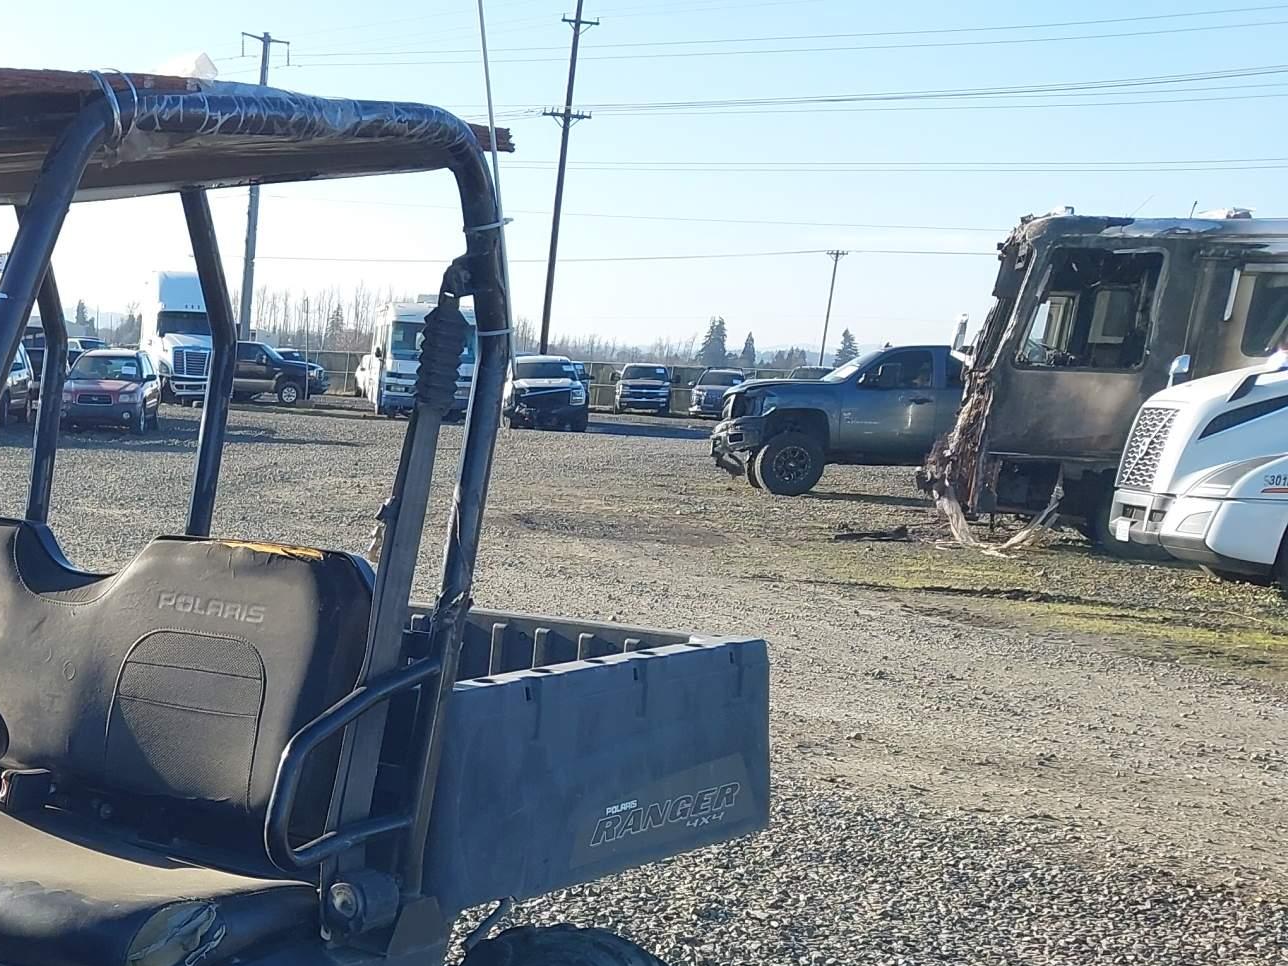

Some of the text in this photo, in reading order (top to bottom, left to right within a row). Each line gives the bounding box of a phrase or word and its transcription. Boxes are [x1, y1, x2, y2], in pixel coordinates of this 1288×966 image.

[157, 591, 267, 624] POLARIS
[589, 781, 742, 846] RANGER
[605, 799, 638, 815] POLARIS
